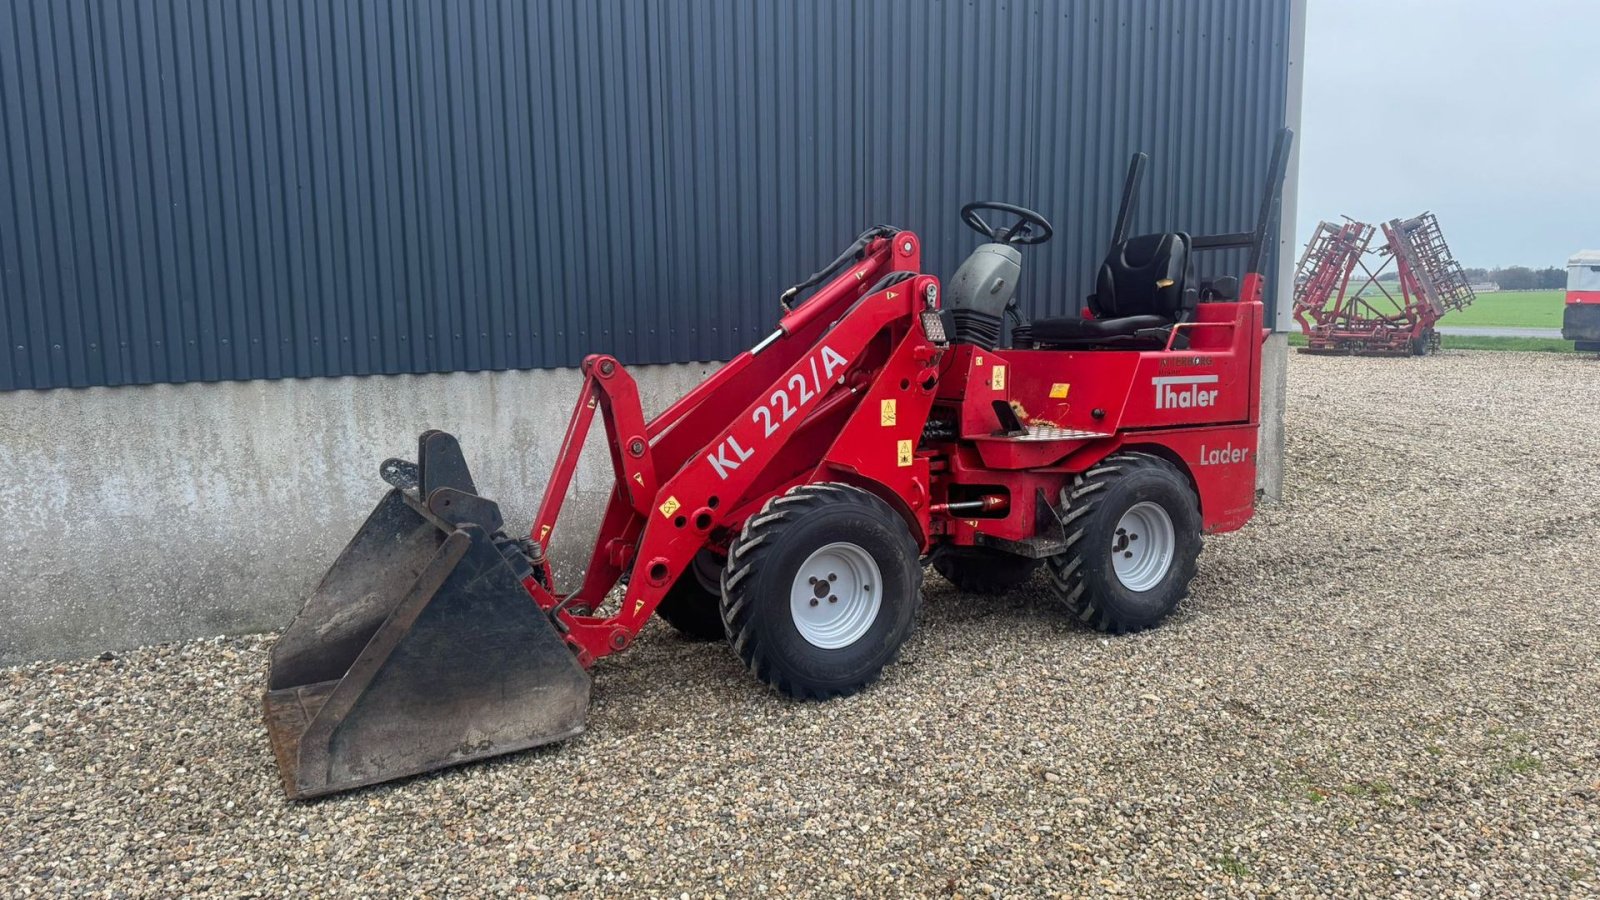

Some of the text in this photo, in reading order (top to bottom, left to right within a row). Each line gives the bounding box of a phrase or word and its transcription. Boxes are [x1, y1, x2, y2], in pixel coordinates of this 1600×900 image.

[1151, 374, 1219, 409] Thaler
[706, 345, 848, 480] KL 222/A
[1200, 441, 1249, 466] Lader
